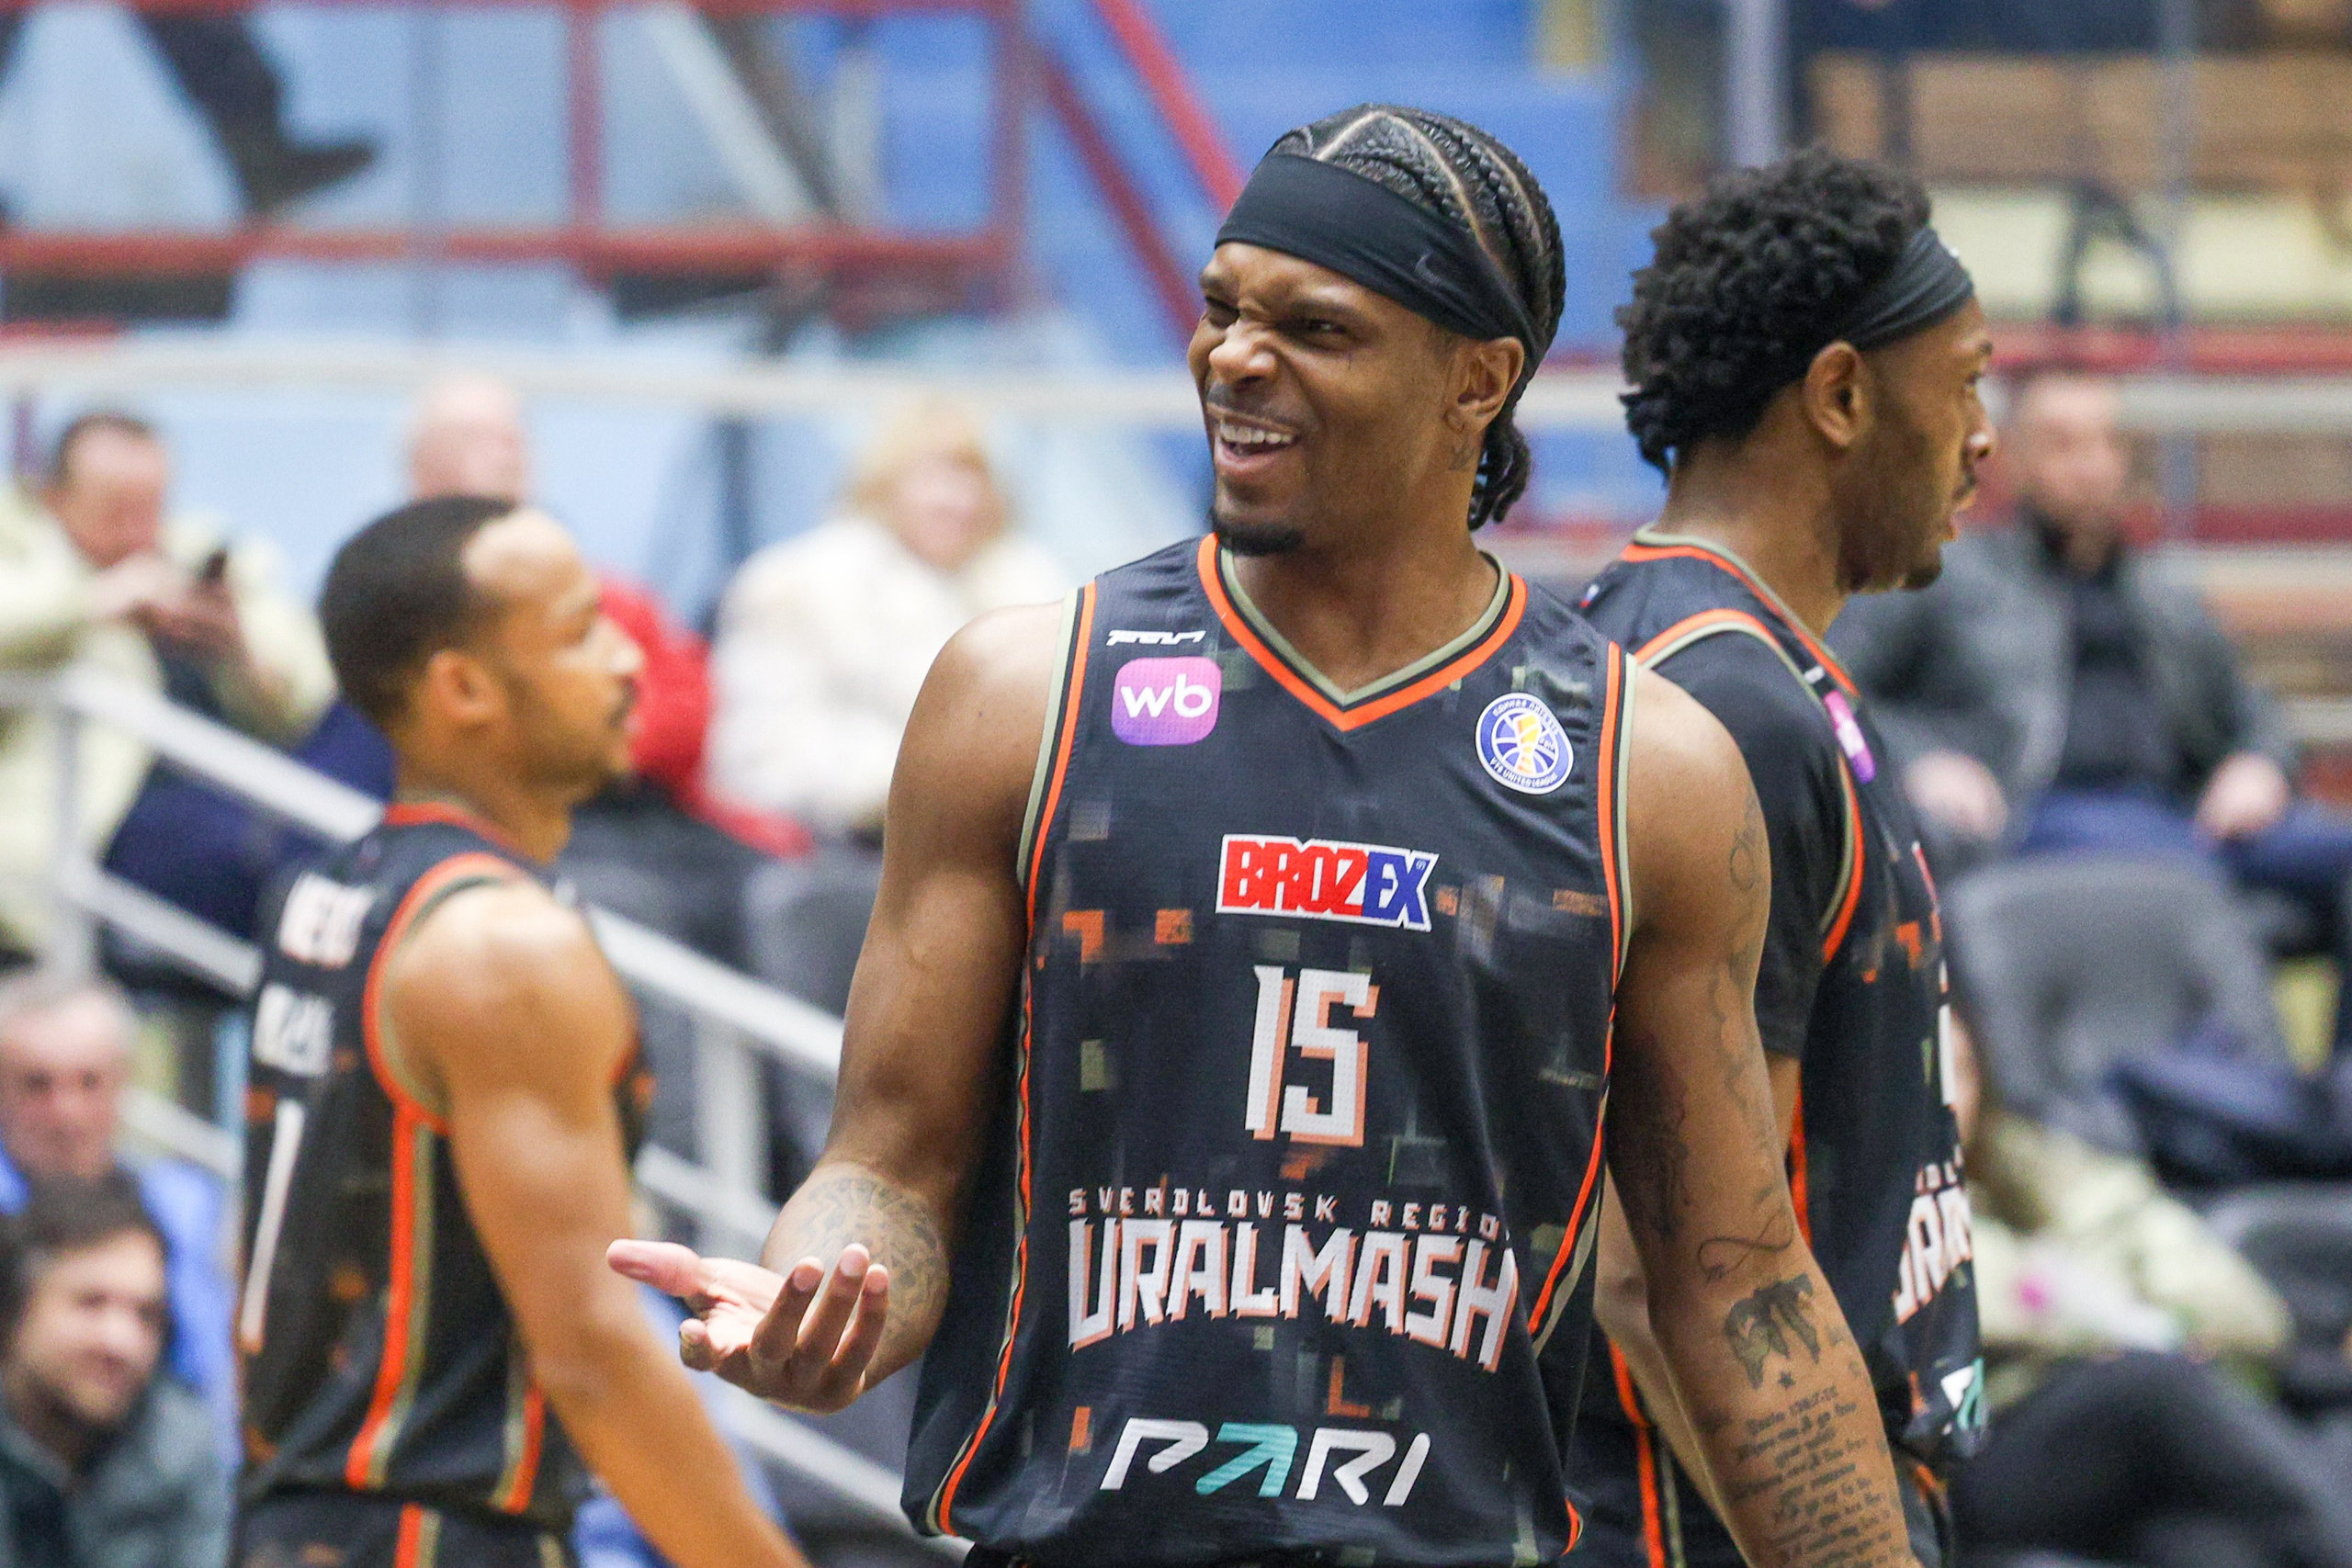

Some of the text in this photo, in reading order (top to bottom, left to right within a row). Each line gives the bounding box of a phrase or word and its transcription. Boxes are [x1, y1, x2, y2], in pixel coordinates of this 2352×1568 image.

[1120, 673, 1213, 718] wb
[1222, 840, 1431, 924] BROZEX
[1244, 964, 1380, 1147] 15
[1069, 1186, 1510, 1242] SVERDLOVSK REGIO
[1069, 1217, 1520, 1373] URALMASH
[1099, 1416, 1431, 1506] PARI
